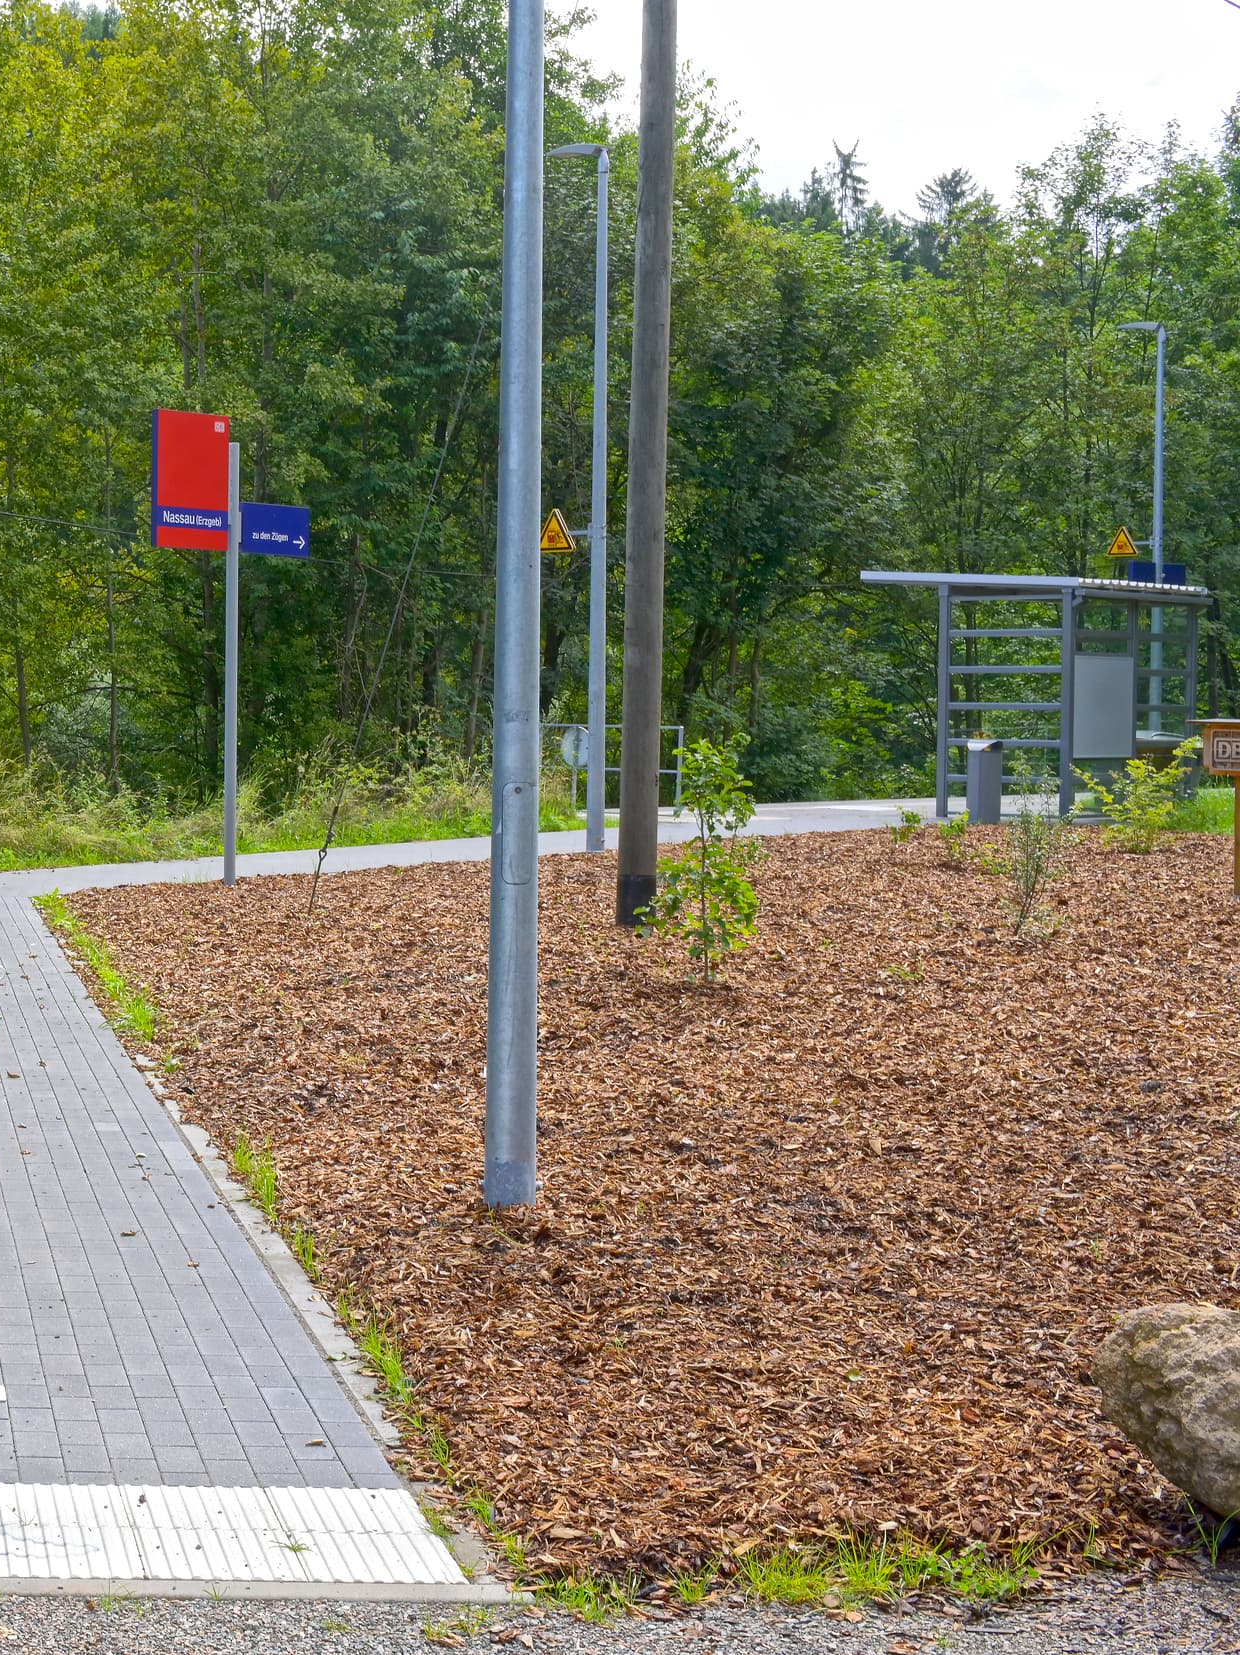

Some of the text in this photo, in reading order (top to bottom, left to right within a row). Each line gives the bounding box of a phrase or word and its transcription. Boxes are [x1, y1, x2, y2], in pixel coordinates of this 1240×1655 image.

[163, 510, 222, 528] Nassau (Erzgeb)
[260, 532, 270, 540] den
[272, 532, 289, 542] Zügen
[1218, 742, 1240, 759] DB
